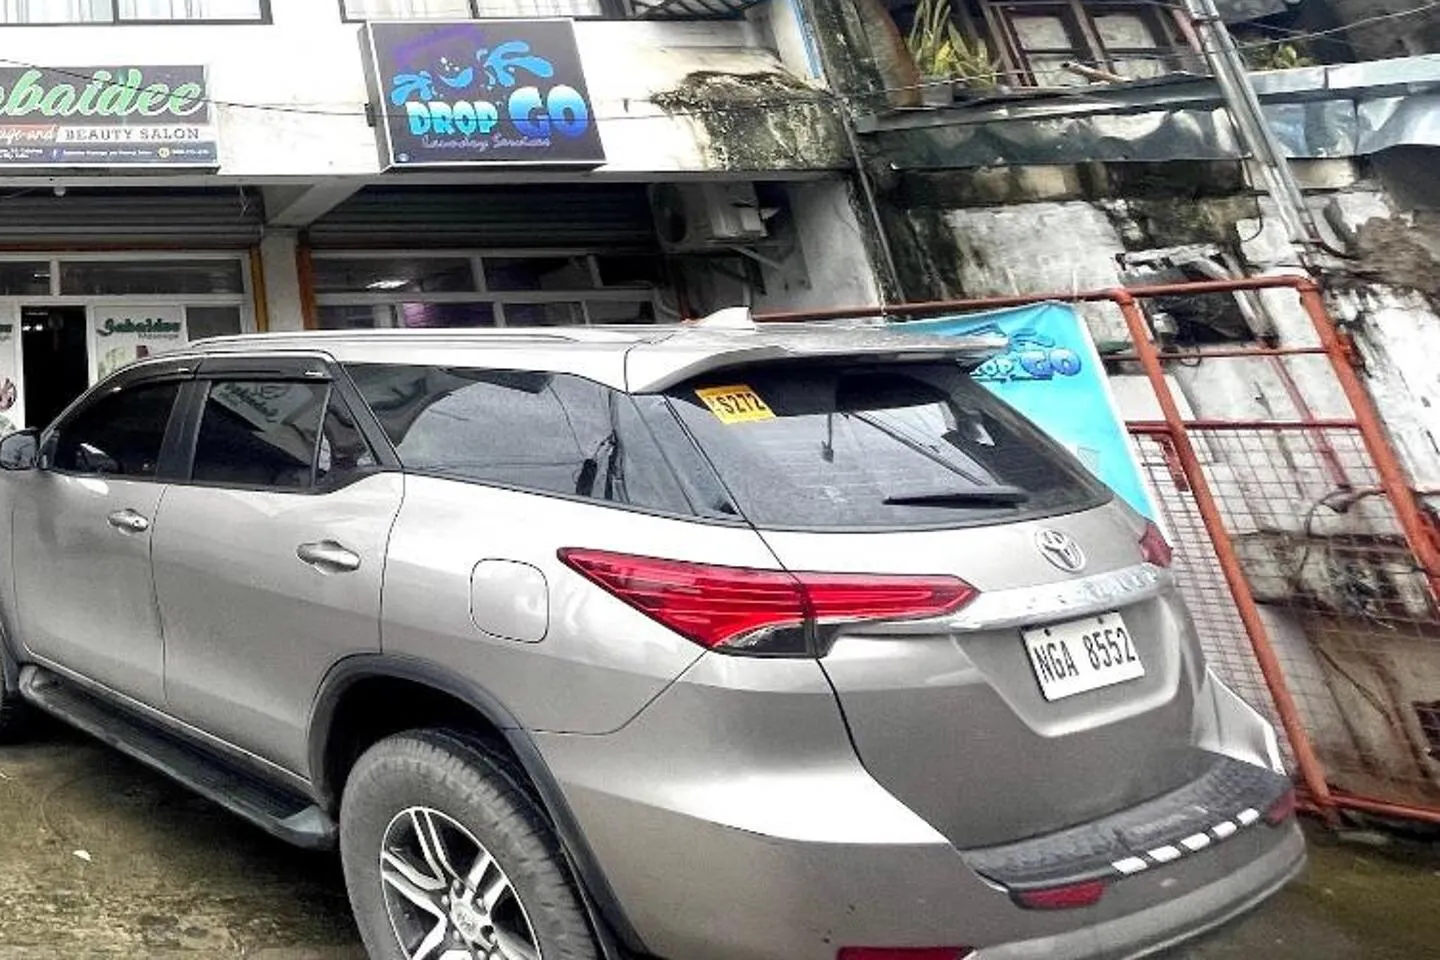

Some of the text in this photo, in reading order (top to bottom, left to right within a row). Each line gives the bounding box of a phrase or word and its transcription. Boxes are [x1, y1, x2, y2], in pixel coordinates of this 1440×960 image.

[405, 84, 589, 138] DROP GO
[64, 127, 133, 141] BEAUTY
[139, 127, 200, 140] SALON
[96, 318, 182, 336] Sabaidee
[1019, 348, 1082, 378] GO
[1033, 626, 1136, 685] NGA 8552
